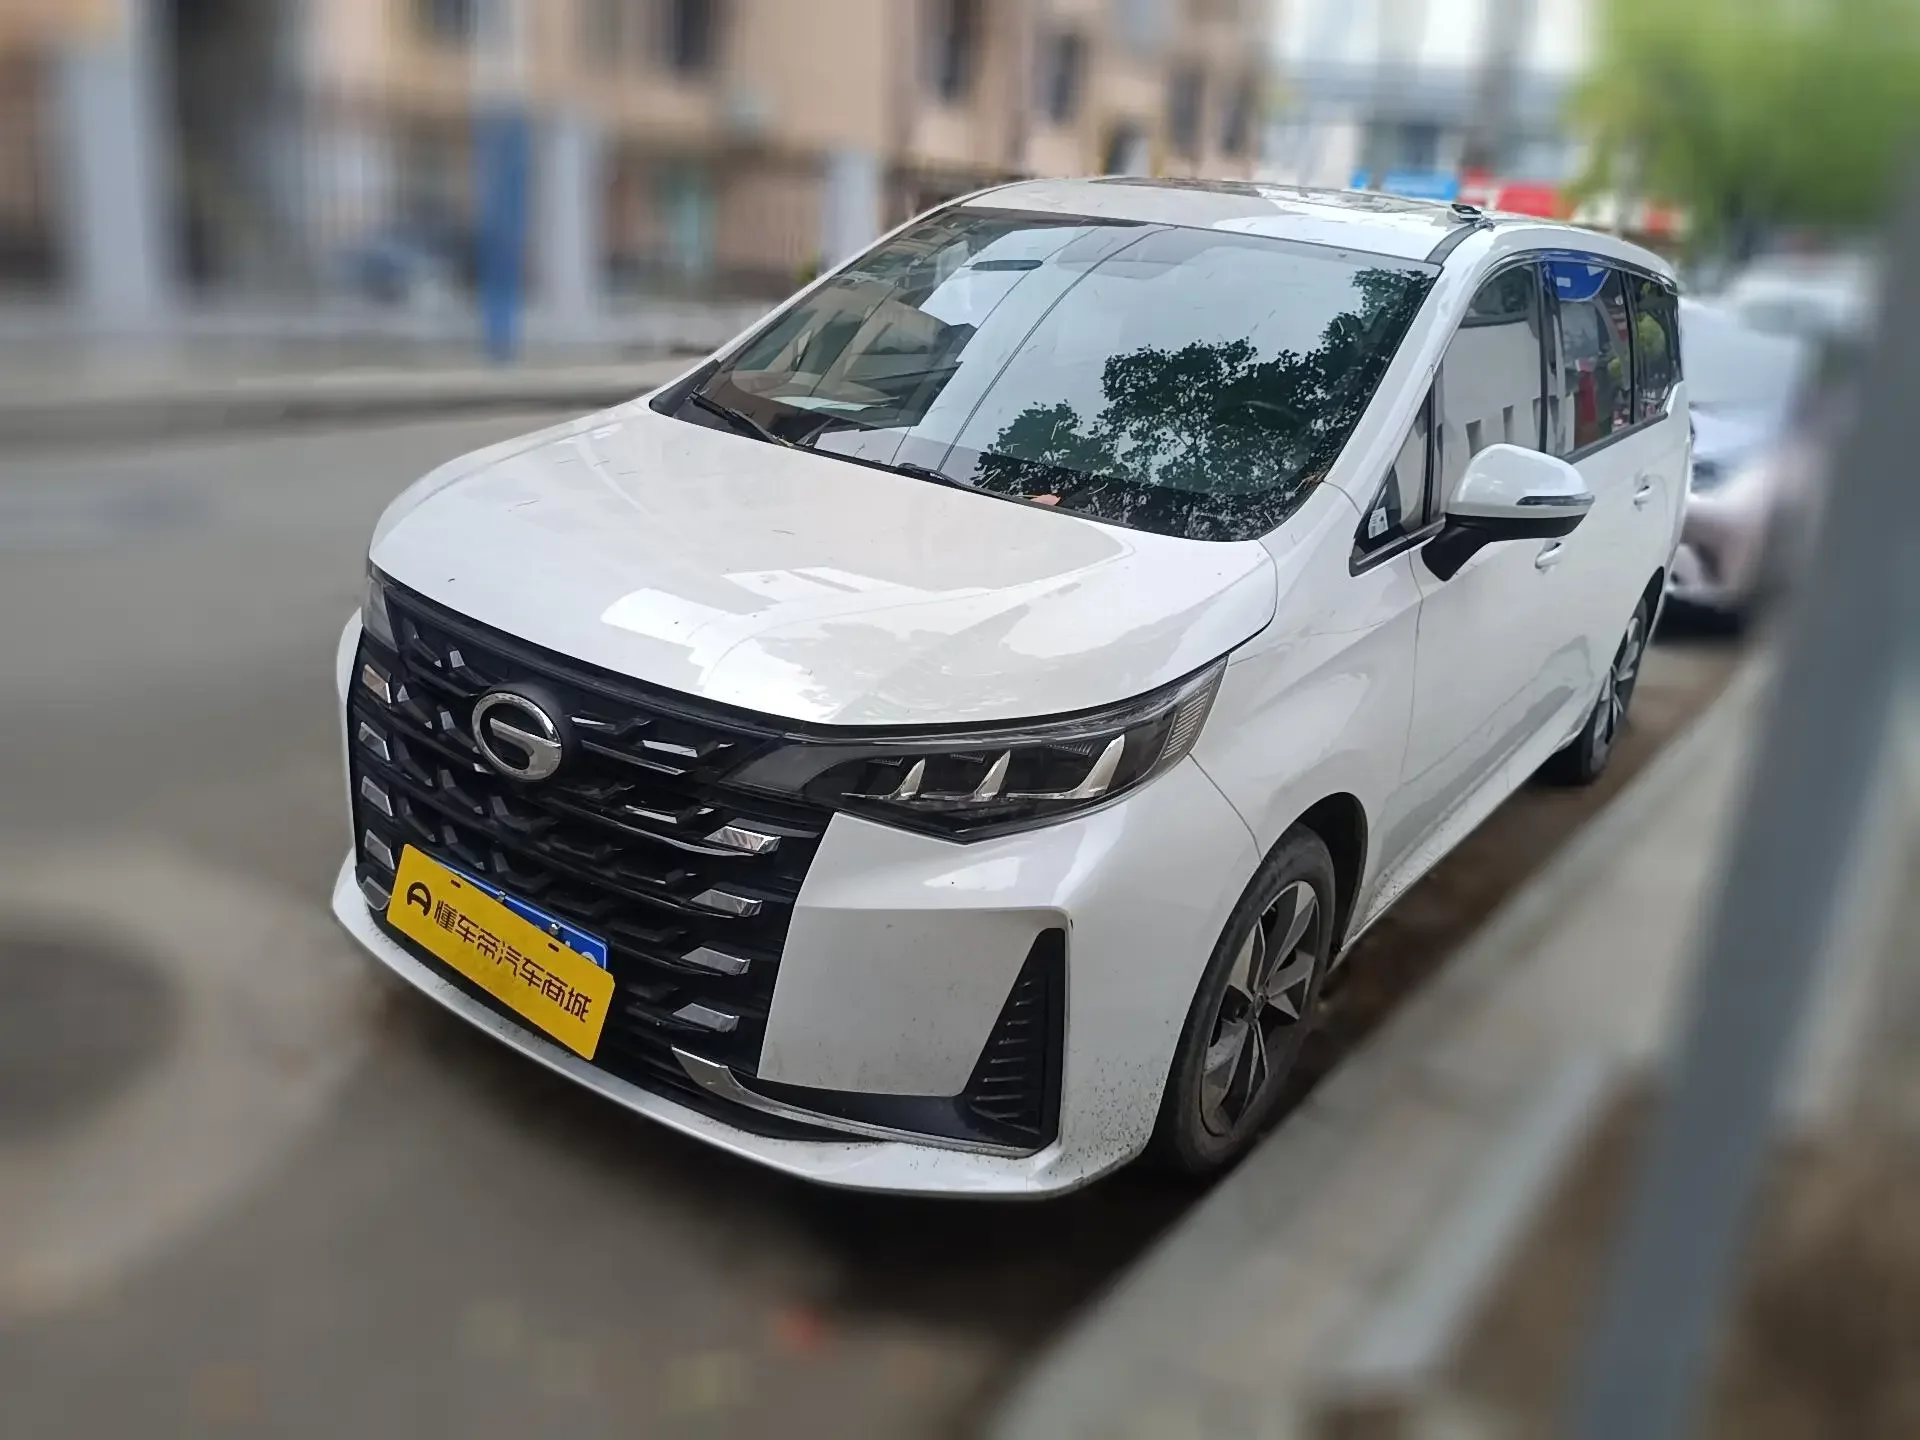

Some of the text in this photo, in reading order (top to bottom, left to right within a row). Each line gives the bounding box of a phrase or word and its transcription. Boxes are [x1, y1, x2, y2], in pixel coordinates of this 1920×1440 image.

[434, 900, 592, 1023] 懂车帝汽车商城
